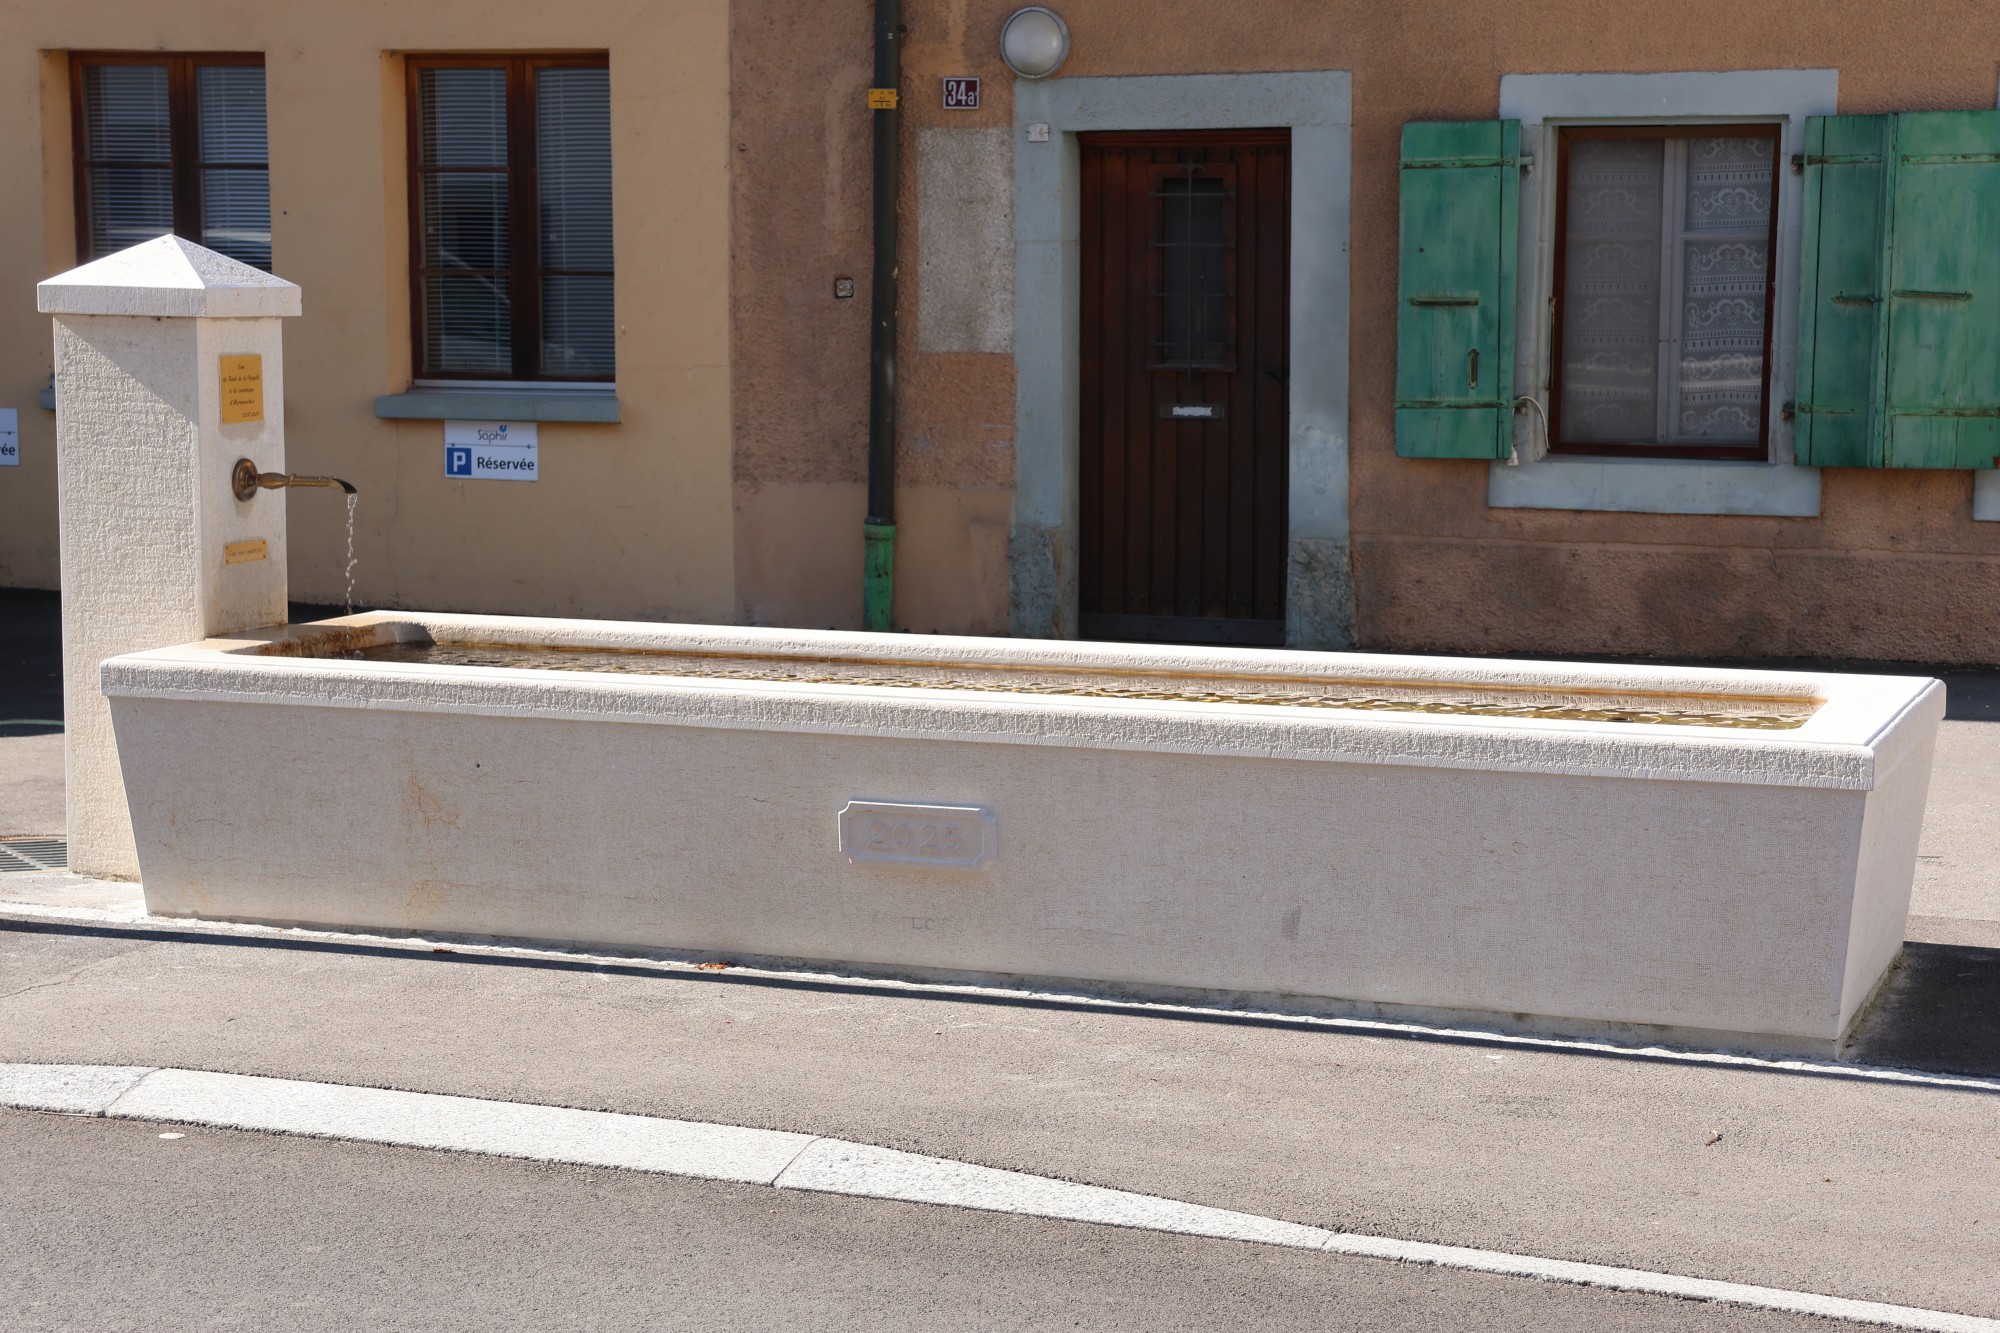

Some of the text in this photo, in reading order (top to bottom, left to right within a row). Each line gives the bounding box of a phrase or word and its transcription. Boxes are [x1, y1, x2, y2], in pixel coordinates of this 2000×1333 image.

[948, 81, 975, 106] 34a
[477, 426, 508, 444] Saphir
[0, 443, 16, 456] ée
[453, 451, 535, 472] P Réservée
[864, 820, 963, 851] 2025
